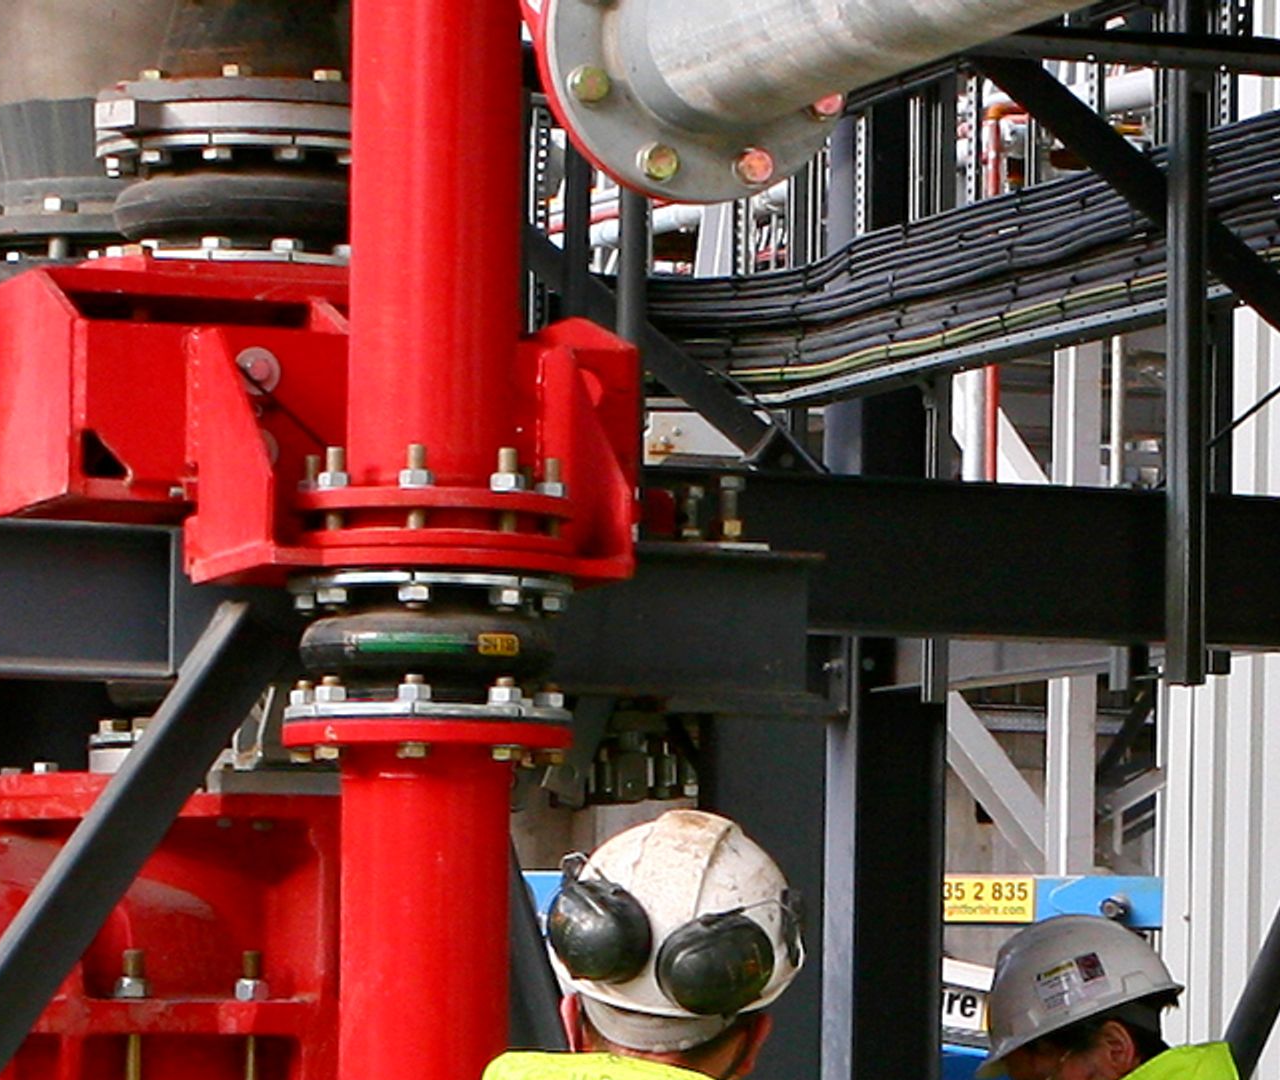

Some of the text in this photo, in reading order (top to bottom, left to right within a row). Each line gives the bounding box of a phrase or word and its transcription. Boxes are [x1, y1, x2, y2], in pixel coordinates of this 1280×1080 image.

[973, 881, 984, 900] 2
[992, 881, 1028, 900] 835
[943, 990, 977, 1018] re
